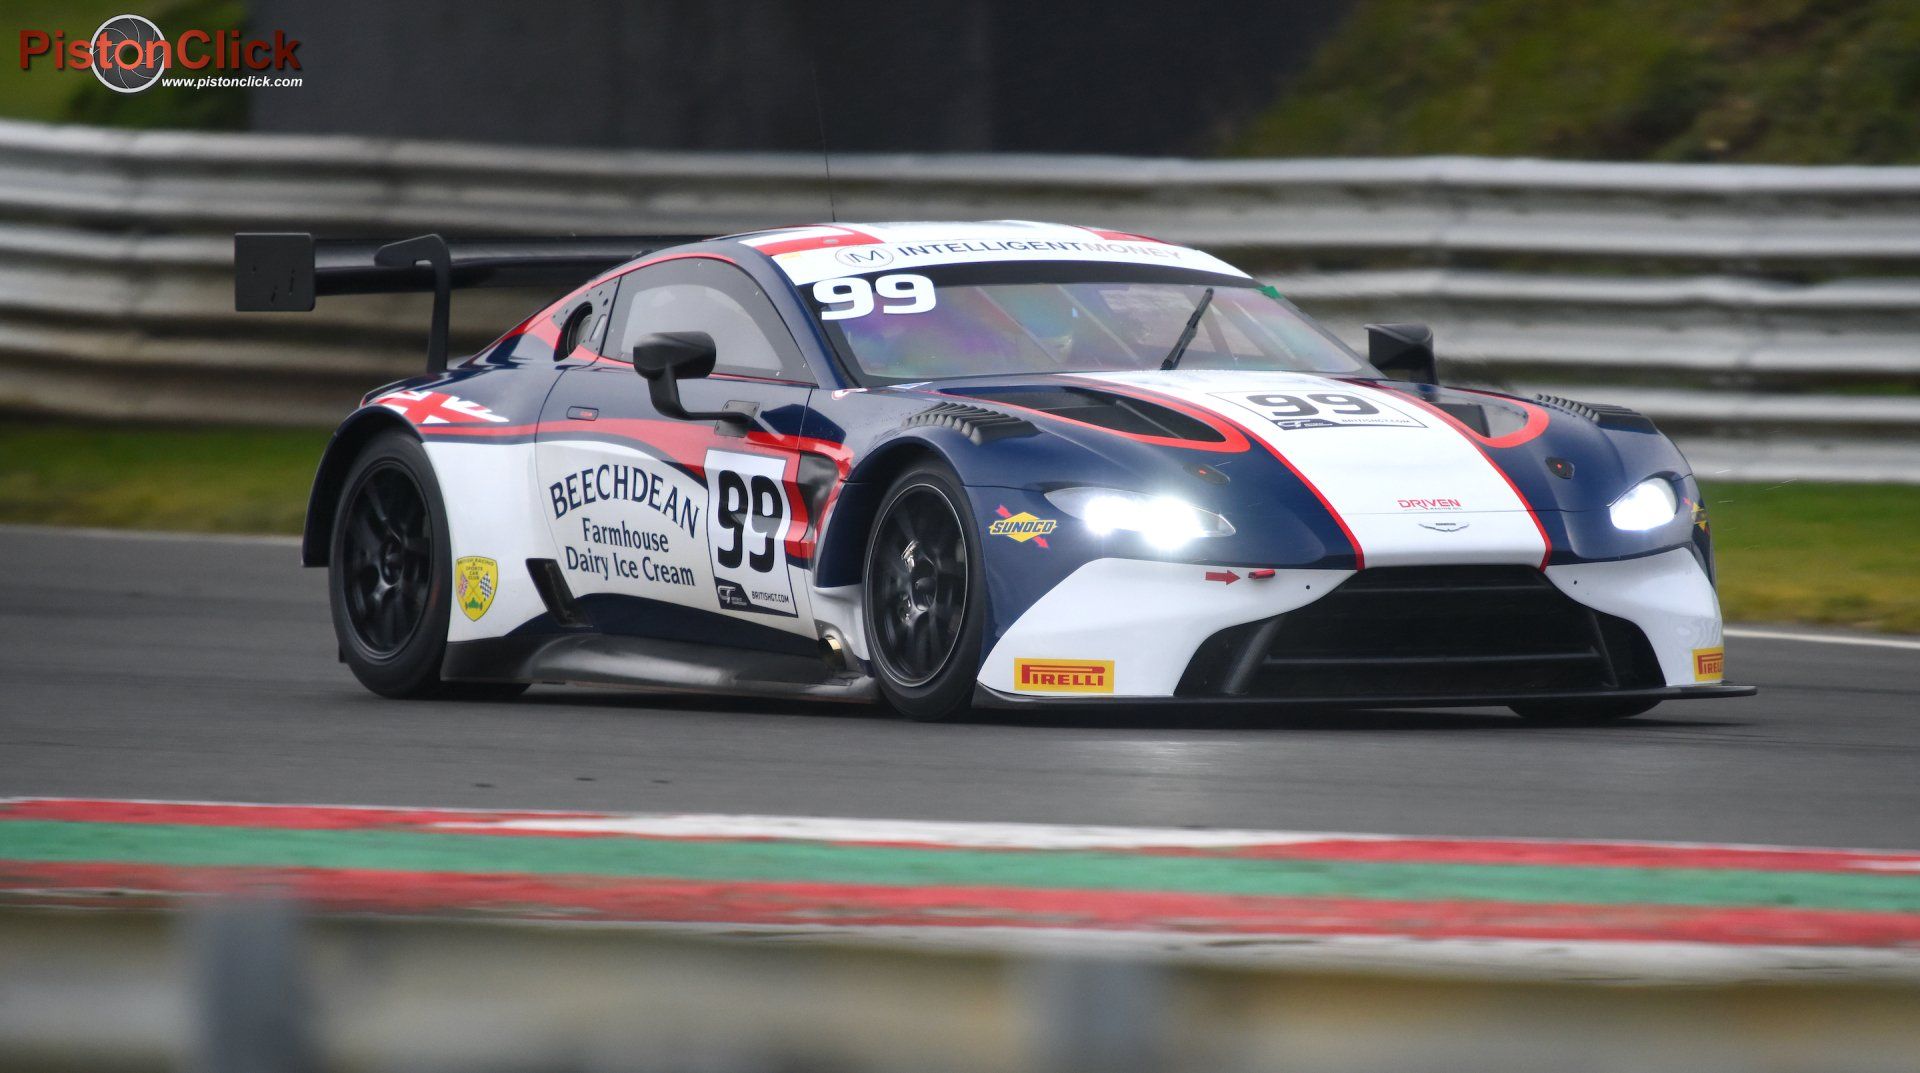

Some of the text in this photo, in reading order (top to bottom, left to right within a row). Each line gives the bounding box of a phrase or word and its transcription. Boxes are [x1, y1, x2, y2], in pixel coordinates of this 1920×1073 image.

[813, 273, 937, 320] 99
[1246, 393, 1380, 417] 99
[549, 464, 700, 539] BEECHDEAN
[1397, 499, 1462, 510] DRIVEN
[582, 517, 669, 553] Farmhouse
[717, 470, 783, 573] 99
[992, 521, 1054, 533] SUNOCO
[565, 545, 696, 587] Dairy Ice Cream
[752, 591, 790, 603] BRITISHGT.COM
[1021, 664, 1106, 687] PIRELLI
